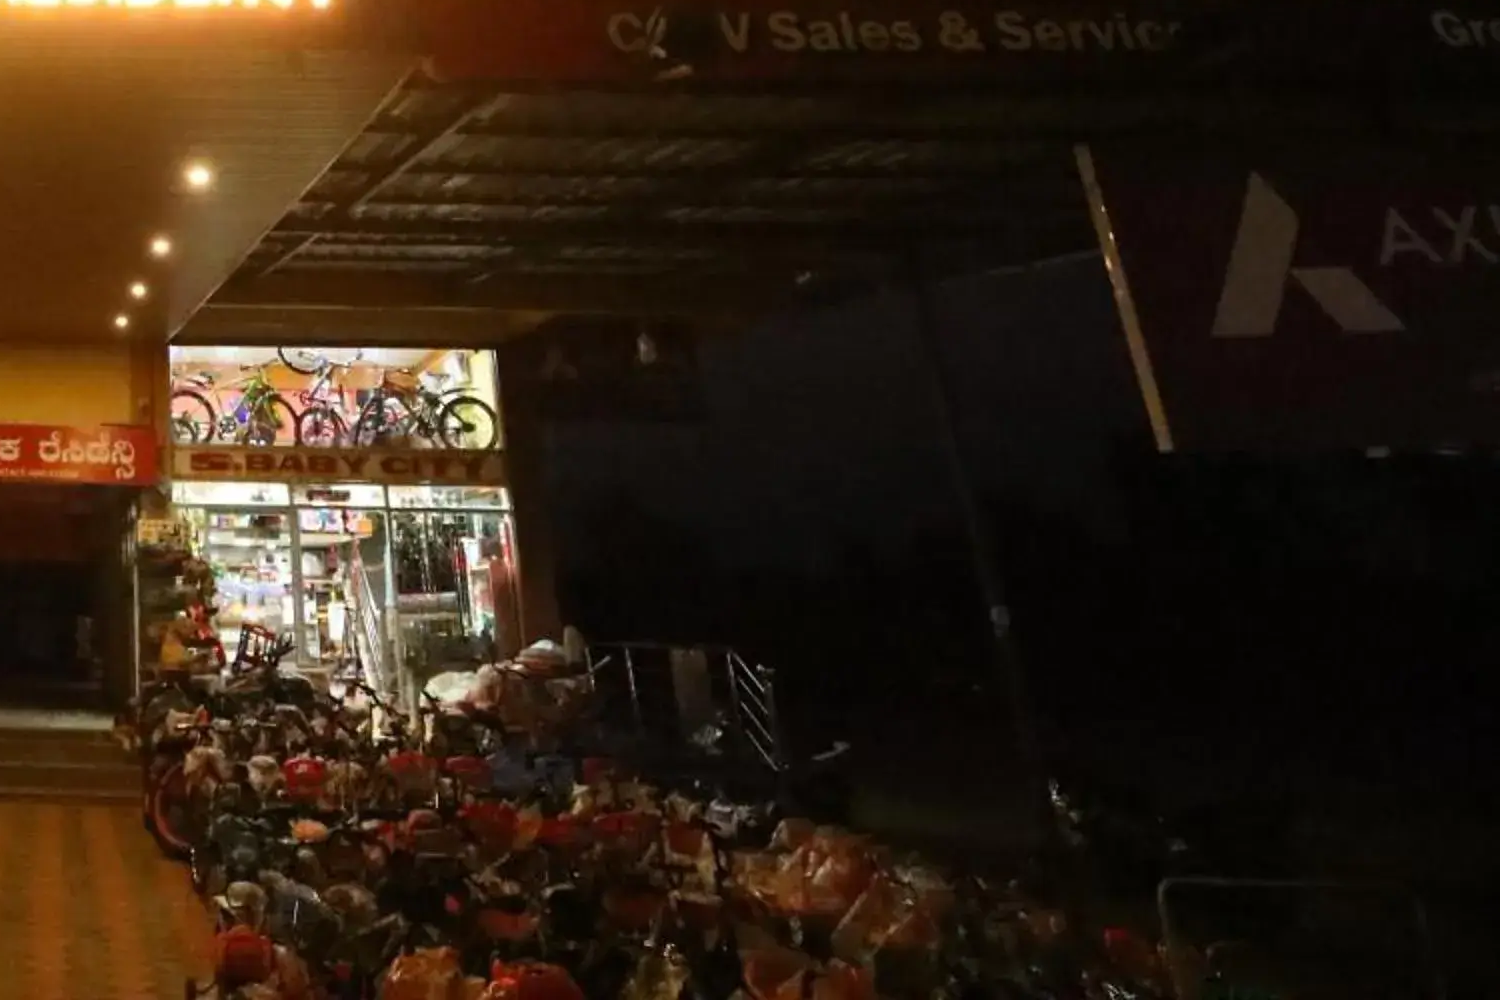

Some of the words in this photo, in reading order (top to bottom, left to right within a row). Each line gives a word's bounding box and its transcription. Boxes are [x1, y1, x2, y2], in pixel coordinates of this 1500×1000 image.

[767, 8, 923, 53] Sales
[938, 9, 985, 53] &
[380, 454, 486, 479] CITY
